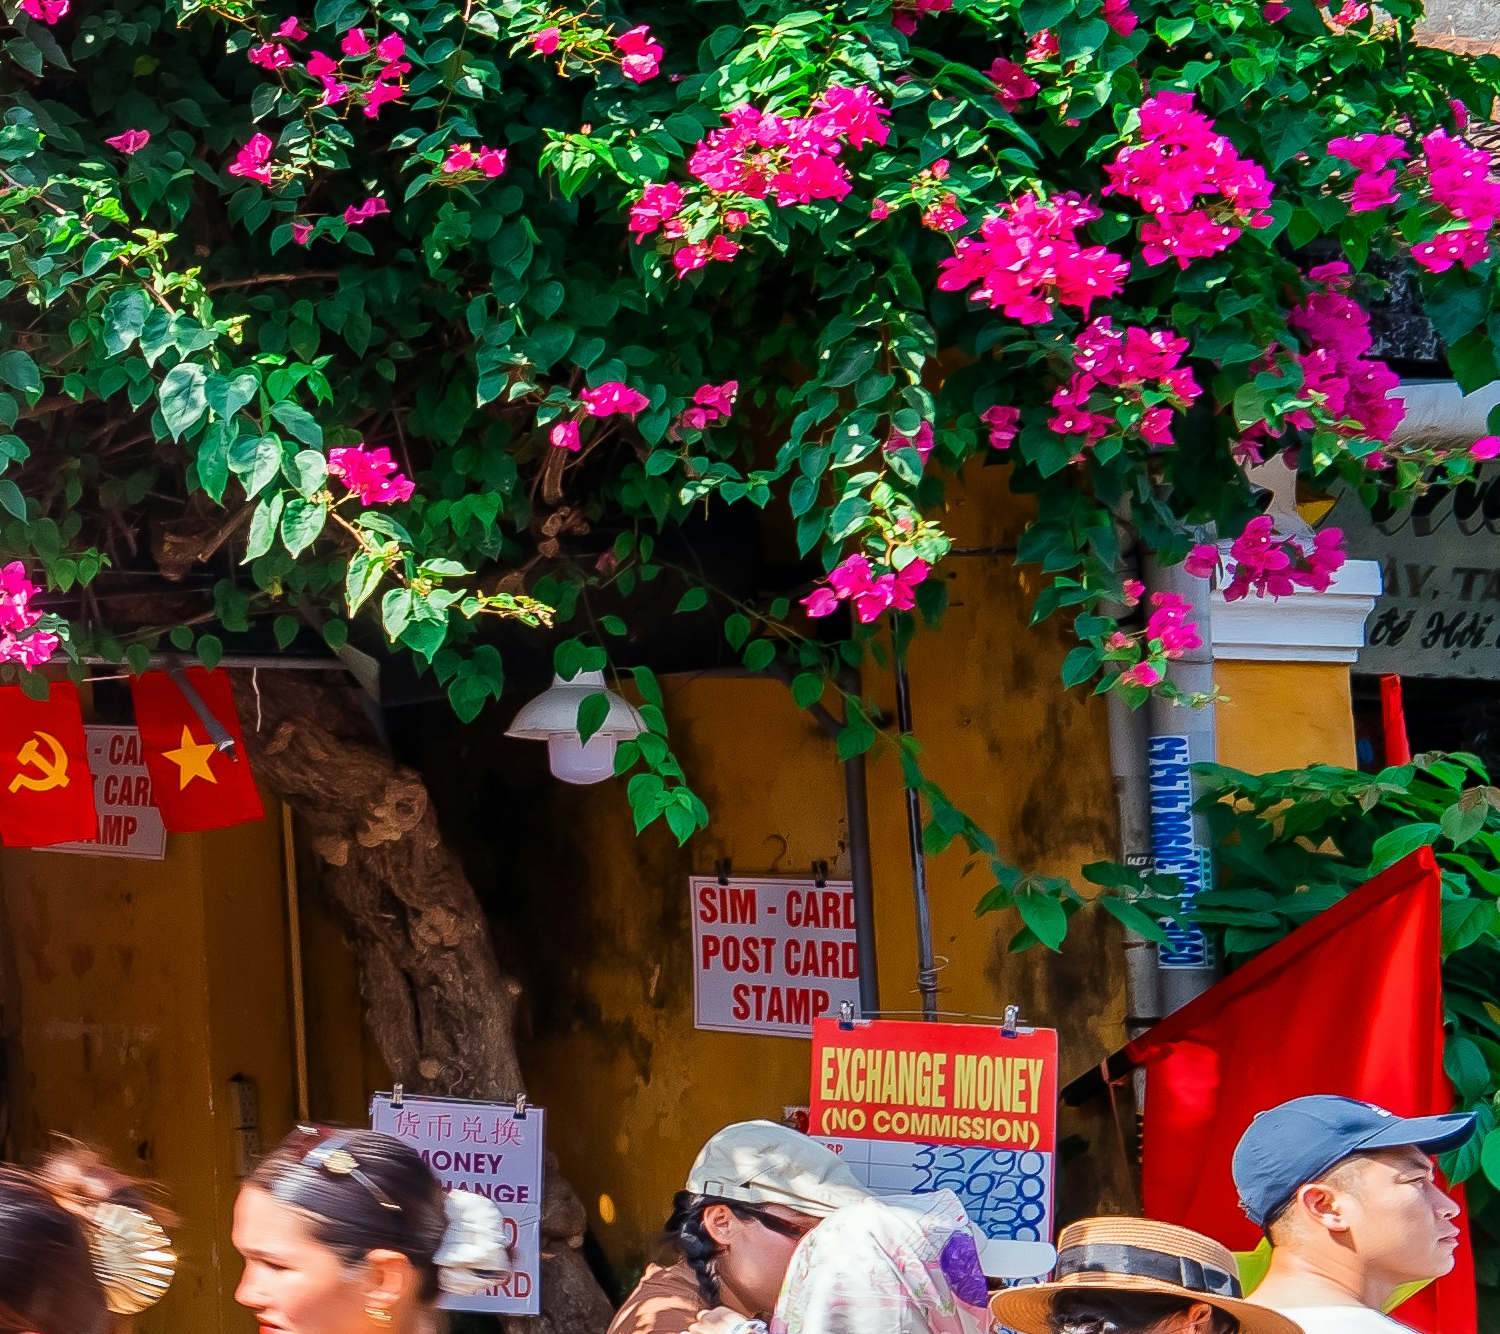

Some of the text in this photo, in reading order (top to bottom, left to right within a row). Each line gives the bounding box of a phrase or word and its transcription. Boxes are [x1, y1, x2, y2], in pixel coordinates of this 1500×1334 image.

[109, 734, 145, 766] CA
[104, 774, 156, 807] CAR
[699, 887, 856, 929] SIM - CARD
[702, 934, 859, 979] POST CARD
[732, 983, 830, 1025] STAMP
[820, 1046, 1044, 1114] EXCHANGE MONEY
[394, 1110, 522, 1147] 货币兑换
[821, 1107, 1040, 1150] (NO COMMISSION)
